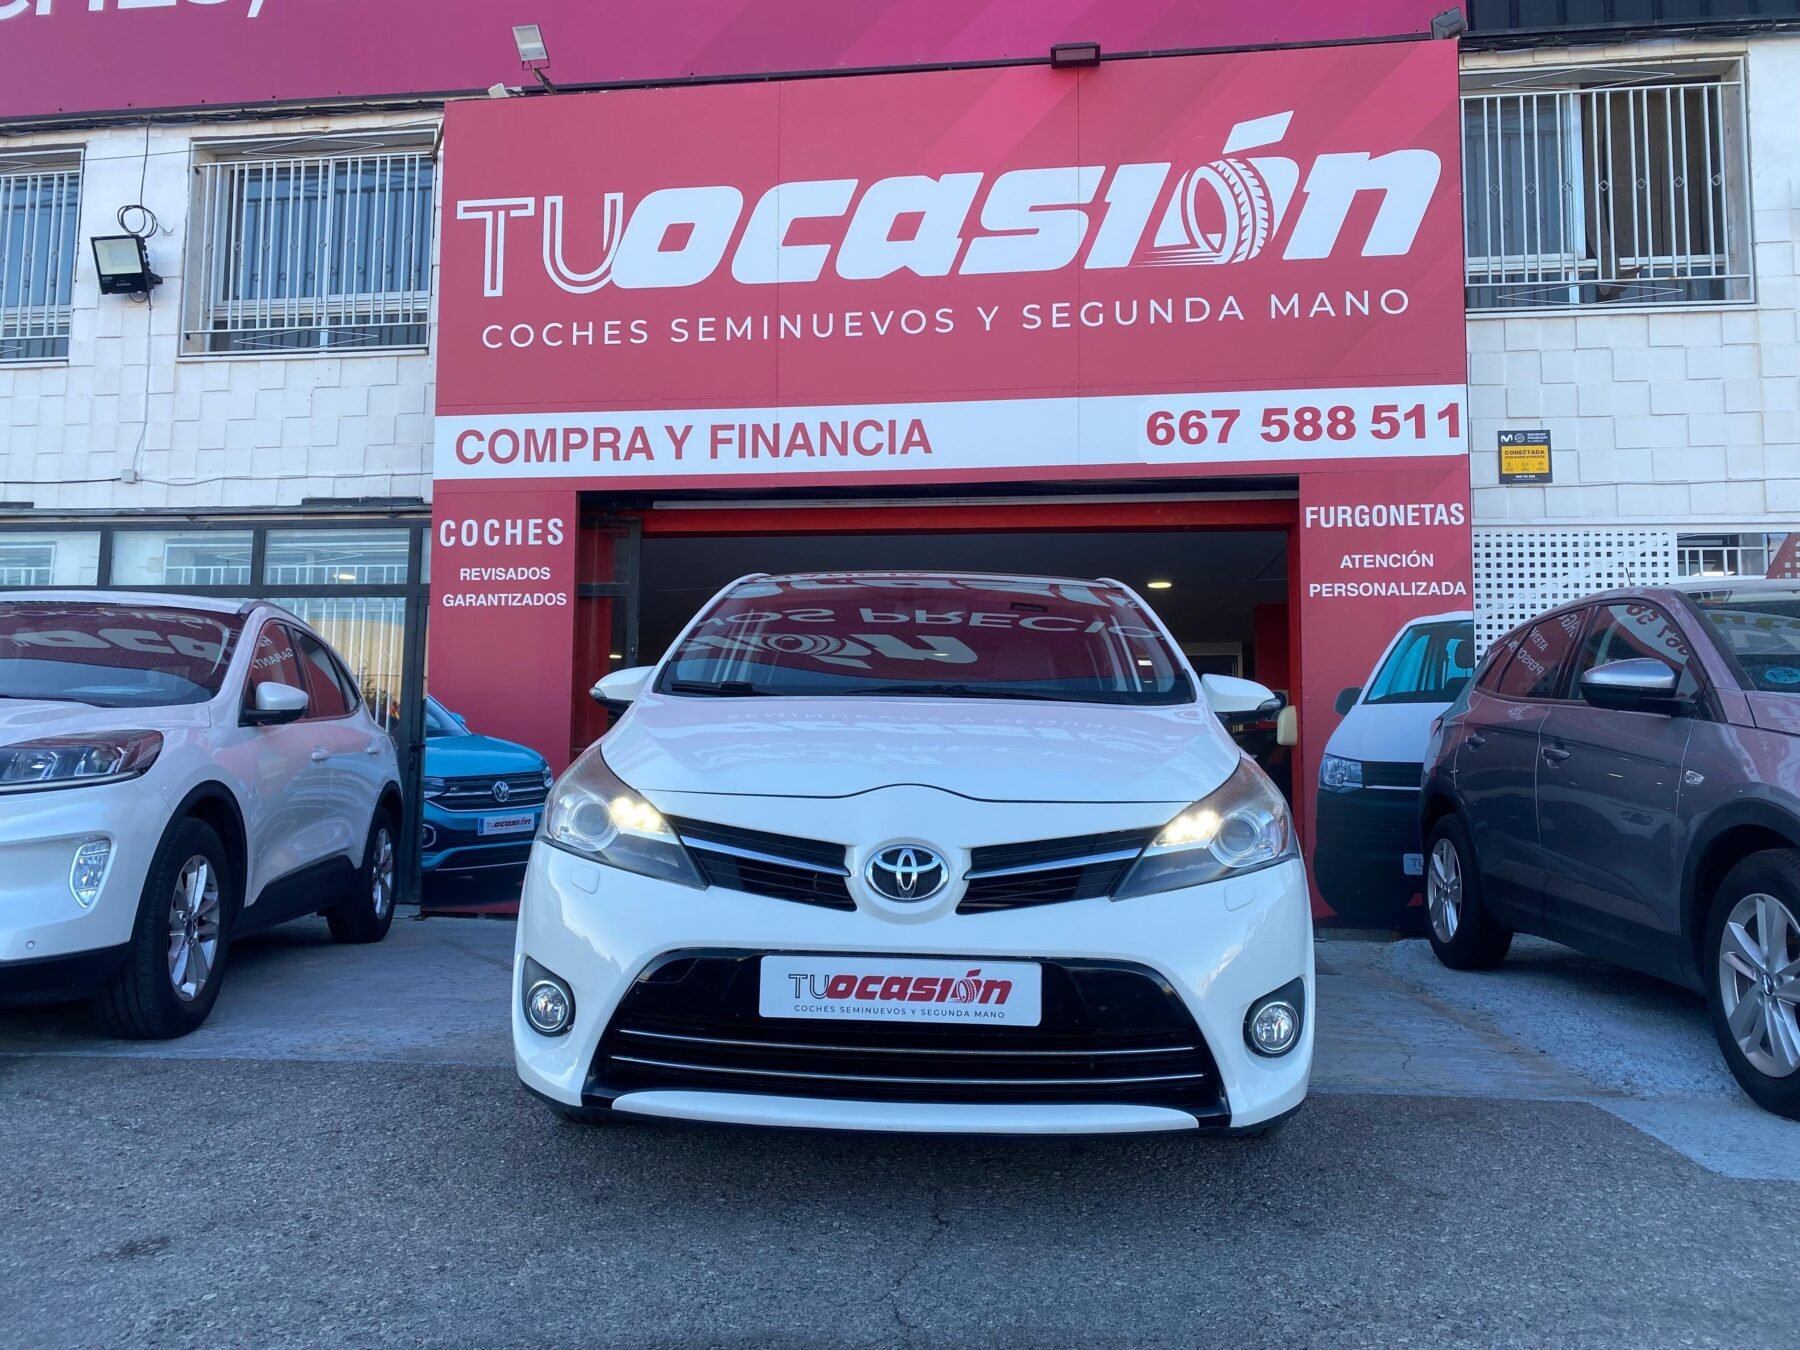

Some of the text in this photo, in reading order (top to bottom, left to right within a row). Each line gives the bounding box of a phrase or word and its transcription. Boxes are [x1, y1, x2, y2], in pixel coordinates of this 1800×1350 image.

[482, 288, 1410, 349] COCHES SEMINUEVOS Y SEGUNDA MANO
[1146, 402, 1460, 446] 667 588 511
[455, 419, 933, 465] COMPRA Y FINANCIA
[1305, 502, 1465, 529] FURGONETAS
[440, 518, 564, 547] COCHES
[1339, 549, 1435, 569] ATENCIÓN
[459, 567, 551, 581] REVISADOS
[442, 592, 567, 607] GARANTIZADOS
[1309, 581, 1467, 598] PERSONALIZADA
[794, 1004, 1005, 1019] COCHES SEMINUEVOS Y SEGUNDA MANO
